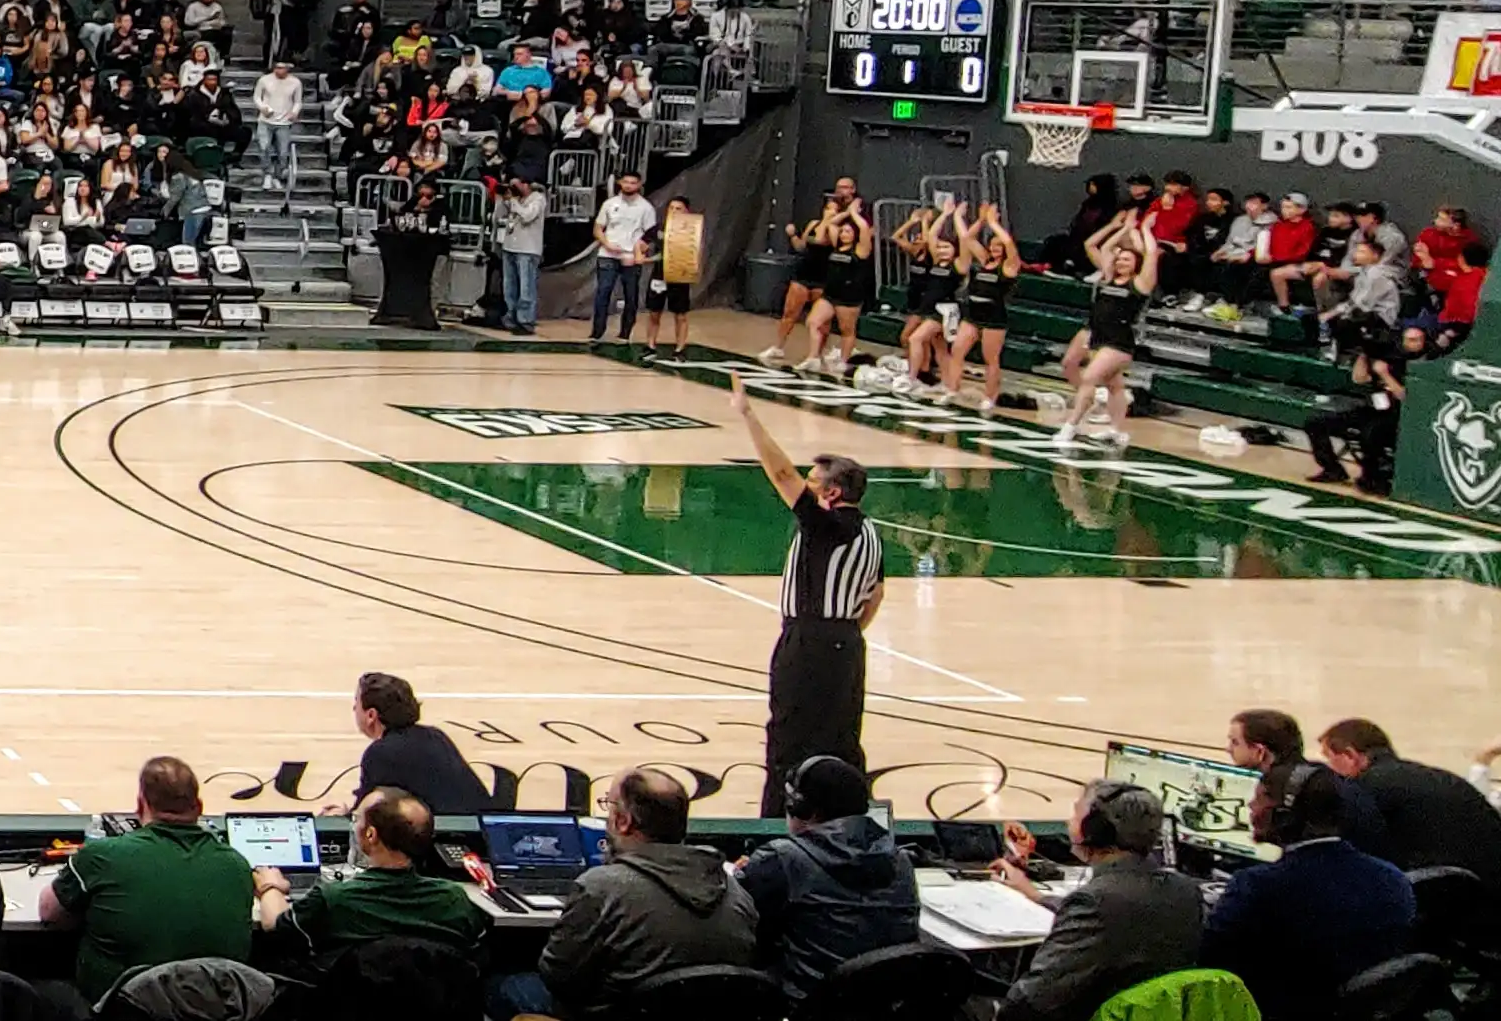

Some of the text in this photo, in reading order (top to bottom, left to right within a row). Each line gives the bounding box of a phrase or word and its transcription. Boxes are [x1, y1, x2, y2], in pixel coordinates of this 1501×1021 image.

[839, 34, 872, 49] HOME
[940, 37, 982, 54] GUEST
[855, 52, 875, 88] 0
[903, 59, 915, 85] 1
[960, 56, 983, 94] 0
[1260, 131, 1379, 170] B08
[429, 413, 614, 437] SKY
[650, 359, 1501, 554] PORTLAND
[444, 719, 769, 746] OUR
